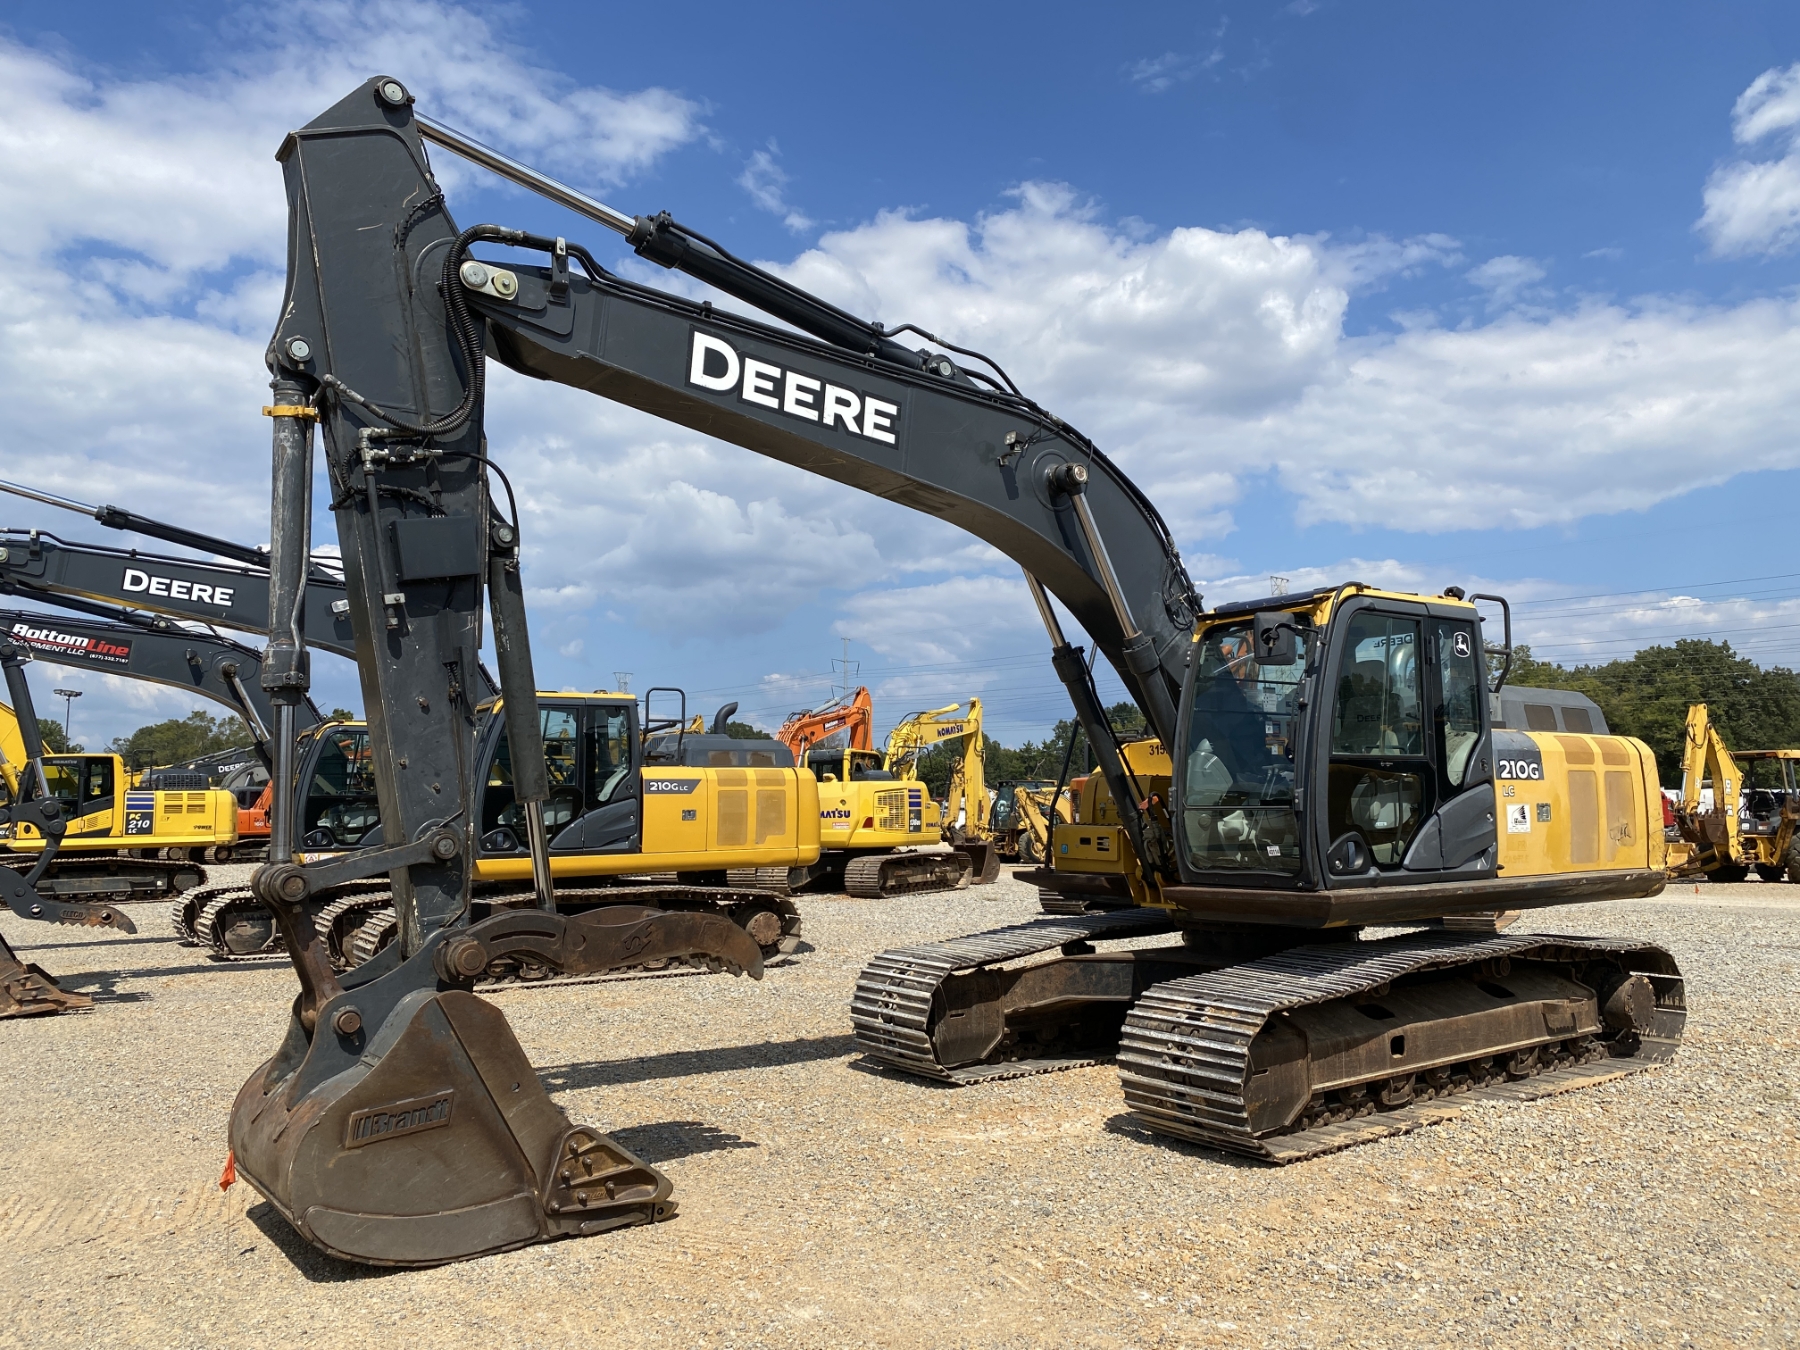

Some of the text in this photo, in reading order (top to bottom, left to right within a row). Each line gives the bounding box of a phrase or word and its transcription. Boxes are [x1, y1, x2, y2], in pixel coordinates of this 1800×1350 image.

[689, 330, 899, 445] DEERE
[122, 568, 234, 607] DEERE
[67, 648, 86, 656] LLC
[937, 724, 963, 738] KOMATSU
[1499, 759, 1540, 780] 210G
[649, 781, 679, 791] 210G
[1502, 785, 1515, 797] LC
[127, 819, 150, 829] 210
[371, 1098, 449, 1136] Brandt
